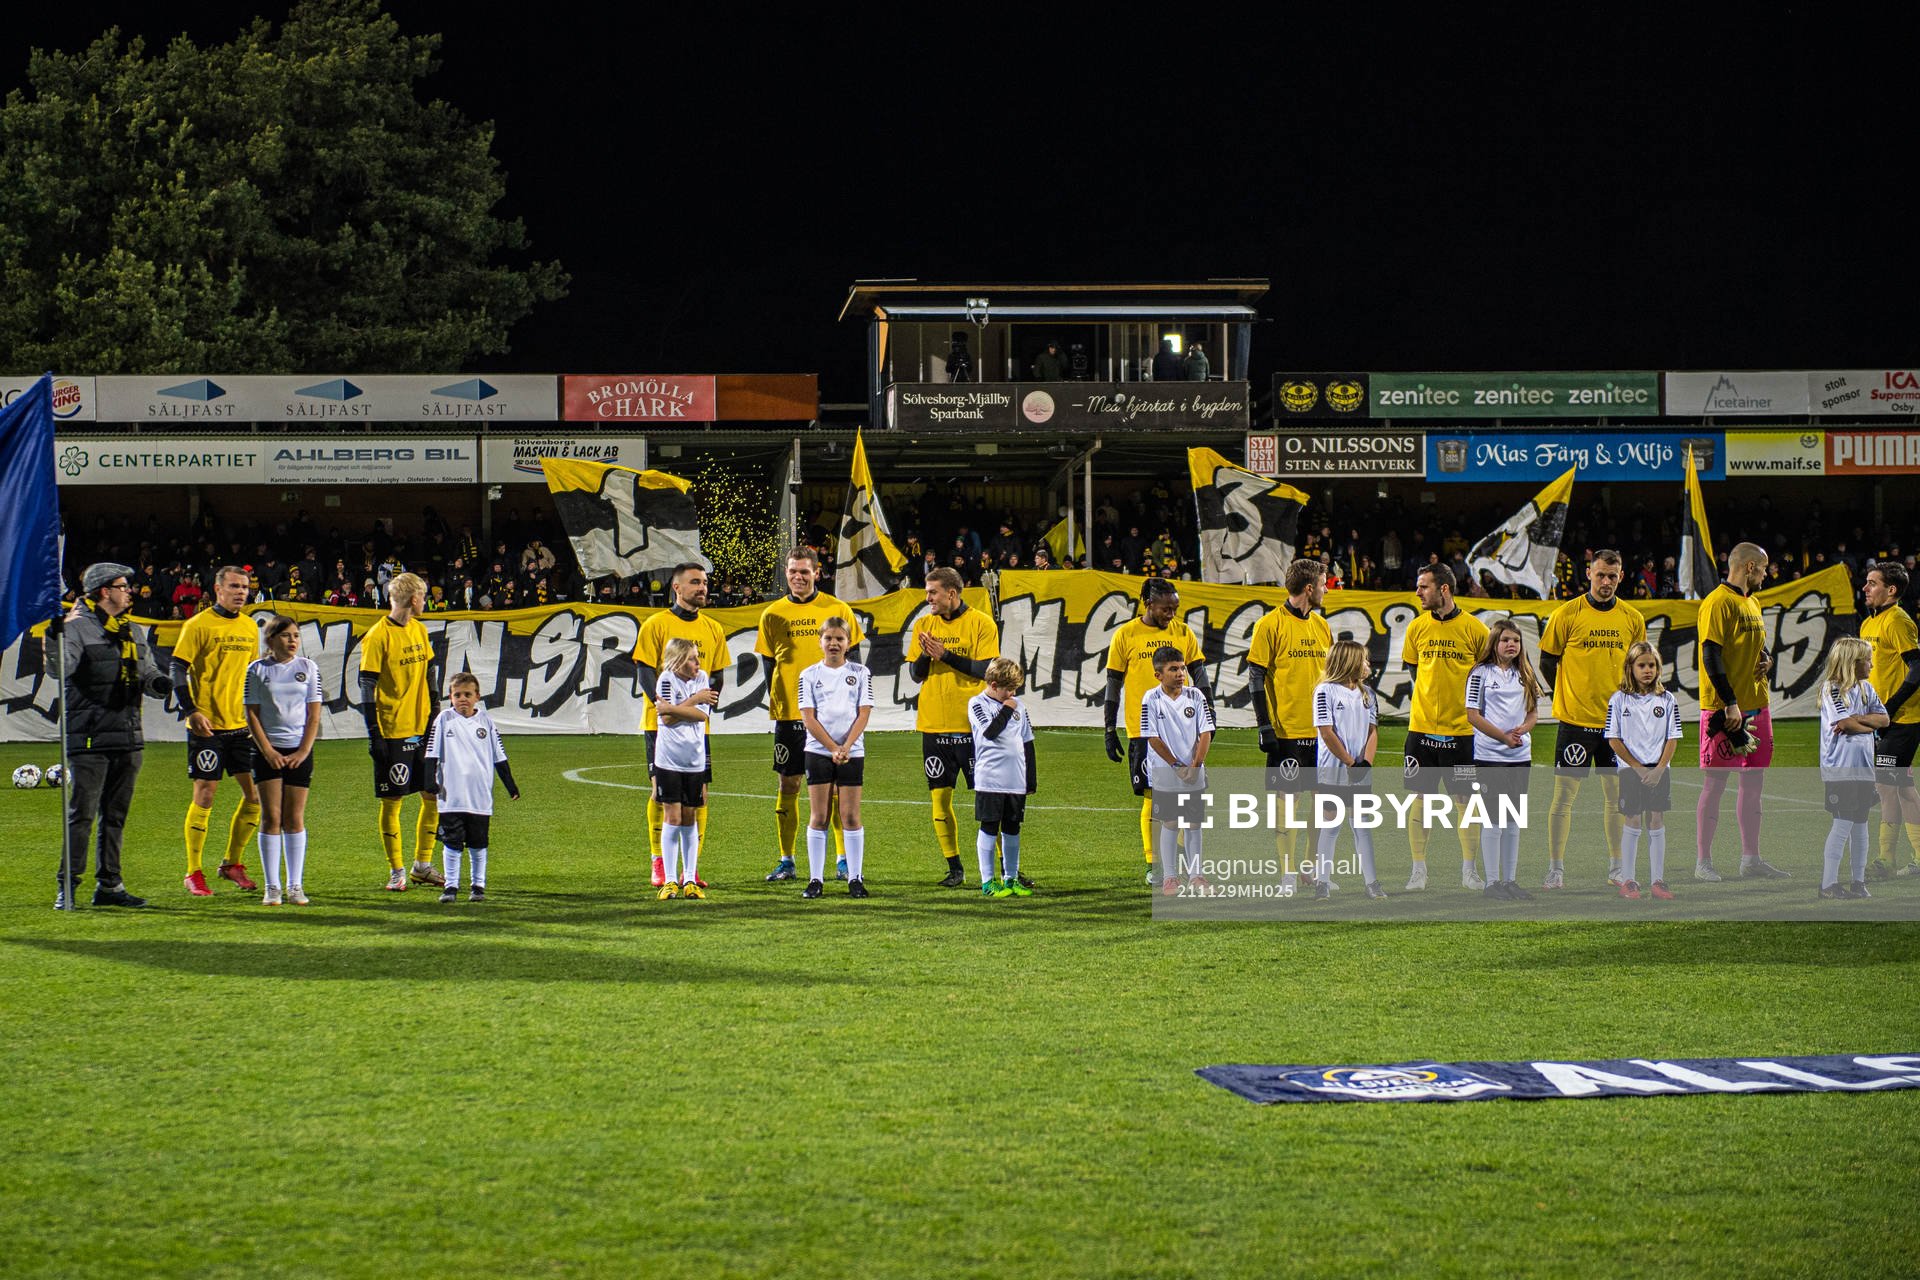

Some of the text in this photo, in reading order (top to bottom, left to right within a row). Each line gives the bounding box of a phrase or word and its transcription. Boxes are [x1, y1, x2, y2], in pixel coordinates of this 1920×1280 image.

[1824, 376, 1847, 392] stolt
[1885, 371, 1920, 390] ICA
[52, 385, 79, 398] URGER
[586, 378, 694, 404] BROMÖLLA
[1379, 383, 1460, 406] zenitec
[1473, 383, 1554, 406] zenitec
[1568, 382, 1648, 404] zenitec
[902, 393, 1011, 407] Sölvesborg-Mjällby
[1713, 396, 1772, 409] icetainer
[1821, 389, 1861, 409] sponsor
[148, 403, 235, 417] SÄLJFAST
[286, 403, 372, 417] SÄLJFAST
[422, 403, 507, 417] SÄLJFAST
[598, 397, 685, 418] CHARK
[1126, 395, 1175, 419] hjärtat
[1180, 398, 1187, 412] i
[1192, 394, 1243, 419] bygden
[1891, 402, 1915, 413] Osby
[930, 408, 984, 422] Sparbank
[513, 438, 576, 446] Sölvesborgs
[1250, 436, 1274, 449] SYD
[1285, 437, 1415, 454] O. NILSSONS
[273, 448, 470, 461] AHLBERG BIL
[513, 445, 619, 458] MASKIN & LACK AB
[1475, 443, 1528, 467] Mias
[1534, 443, 1589, 470] Färg
[1595, 443, 1613, 465] &
[1618, 442, 1673, 470] Miljö
[1834, 435, 1920, 466] PUMA
[99, 453, 257, 468] CENTERPARTIET
[1285, 459, 1417, 471] STEN & HANTVERK
[1729, 456, 1822, 470] www.maif.se
[790, 618, 817, 627] ROGER
[786, 628, 820, 638] PERSSON
[1589, 629, 1620, 637] ANDERS
[1146, 640, 1173, 648] ANTON
[1429, 639, 1456, 648] DANIEL
[1583, 640, 1624, 649] HOLMBERG
[1287, 649, 1327, 658] SÖDERLIND
[1420, 737, 1457, 749] SÄLJFAST
